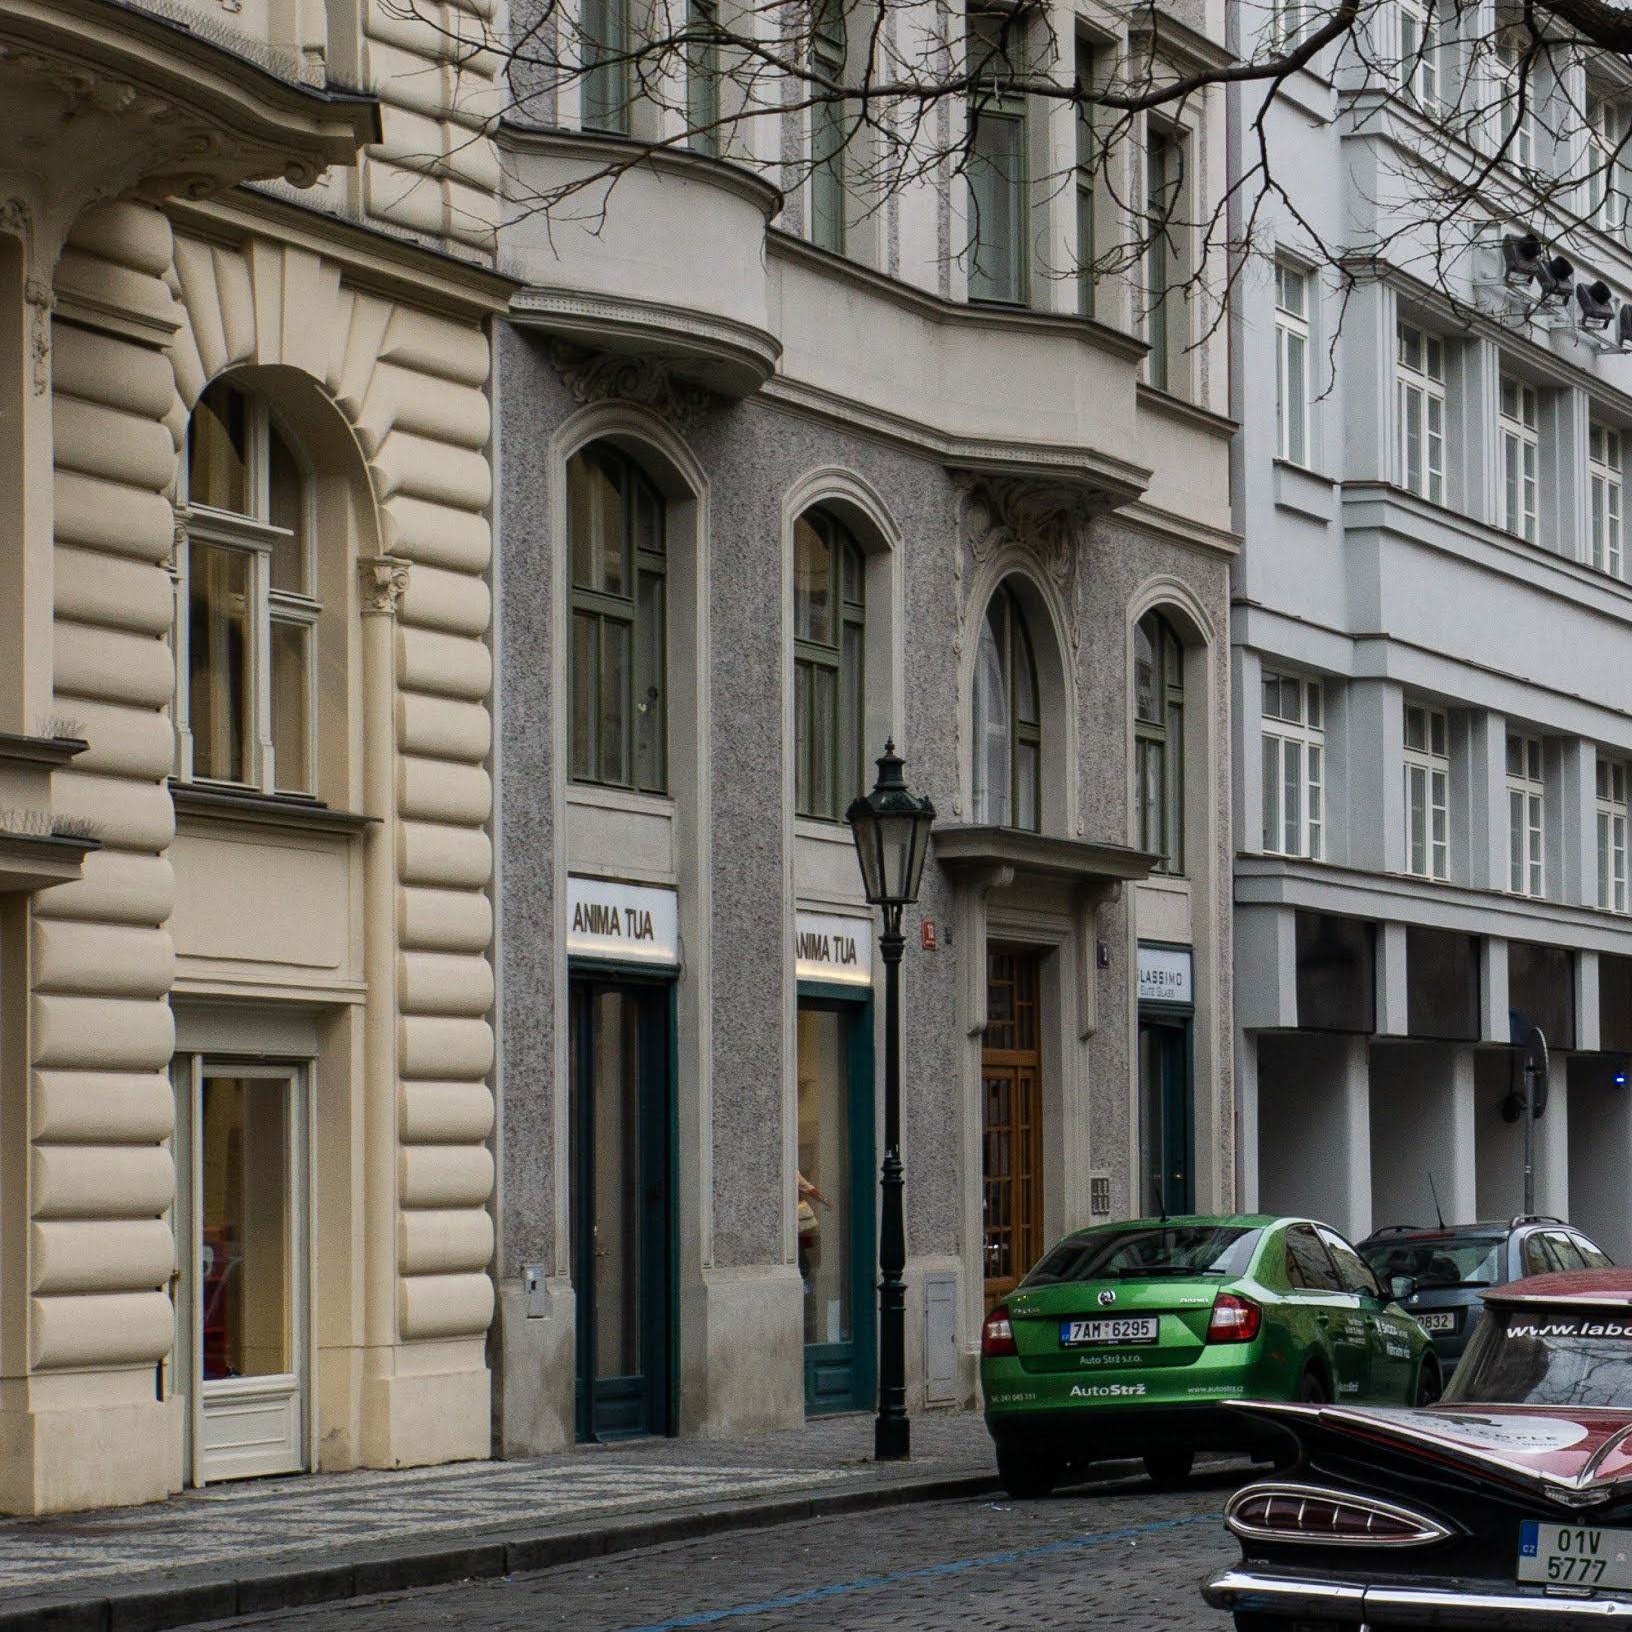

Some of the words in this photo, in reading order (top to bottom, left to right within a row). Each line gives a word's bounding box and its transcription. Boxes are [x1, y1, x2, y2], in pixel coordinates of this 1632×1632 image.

[573, 901, 621, 937] ANIMA
[625, 907, 654, 941] TUA
[833, 935, 857, 965] TUA
[1138, 969, 1182, 986] LASSIMO
[1073, 1322, 1101, 1339] 7AM
[1112, 1320, 1149, 1337] 6295
[1080, 1355, 1102, 1365] Auto
[1069, 1383, 1146, 1397] AutoStrž
[1522, 1544, 1536, 1553] CZ
[1558, 1528, 1601, 1554] 01V
[1547, 1555, 1607, 1582] 5777
